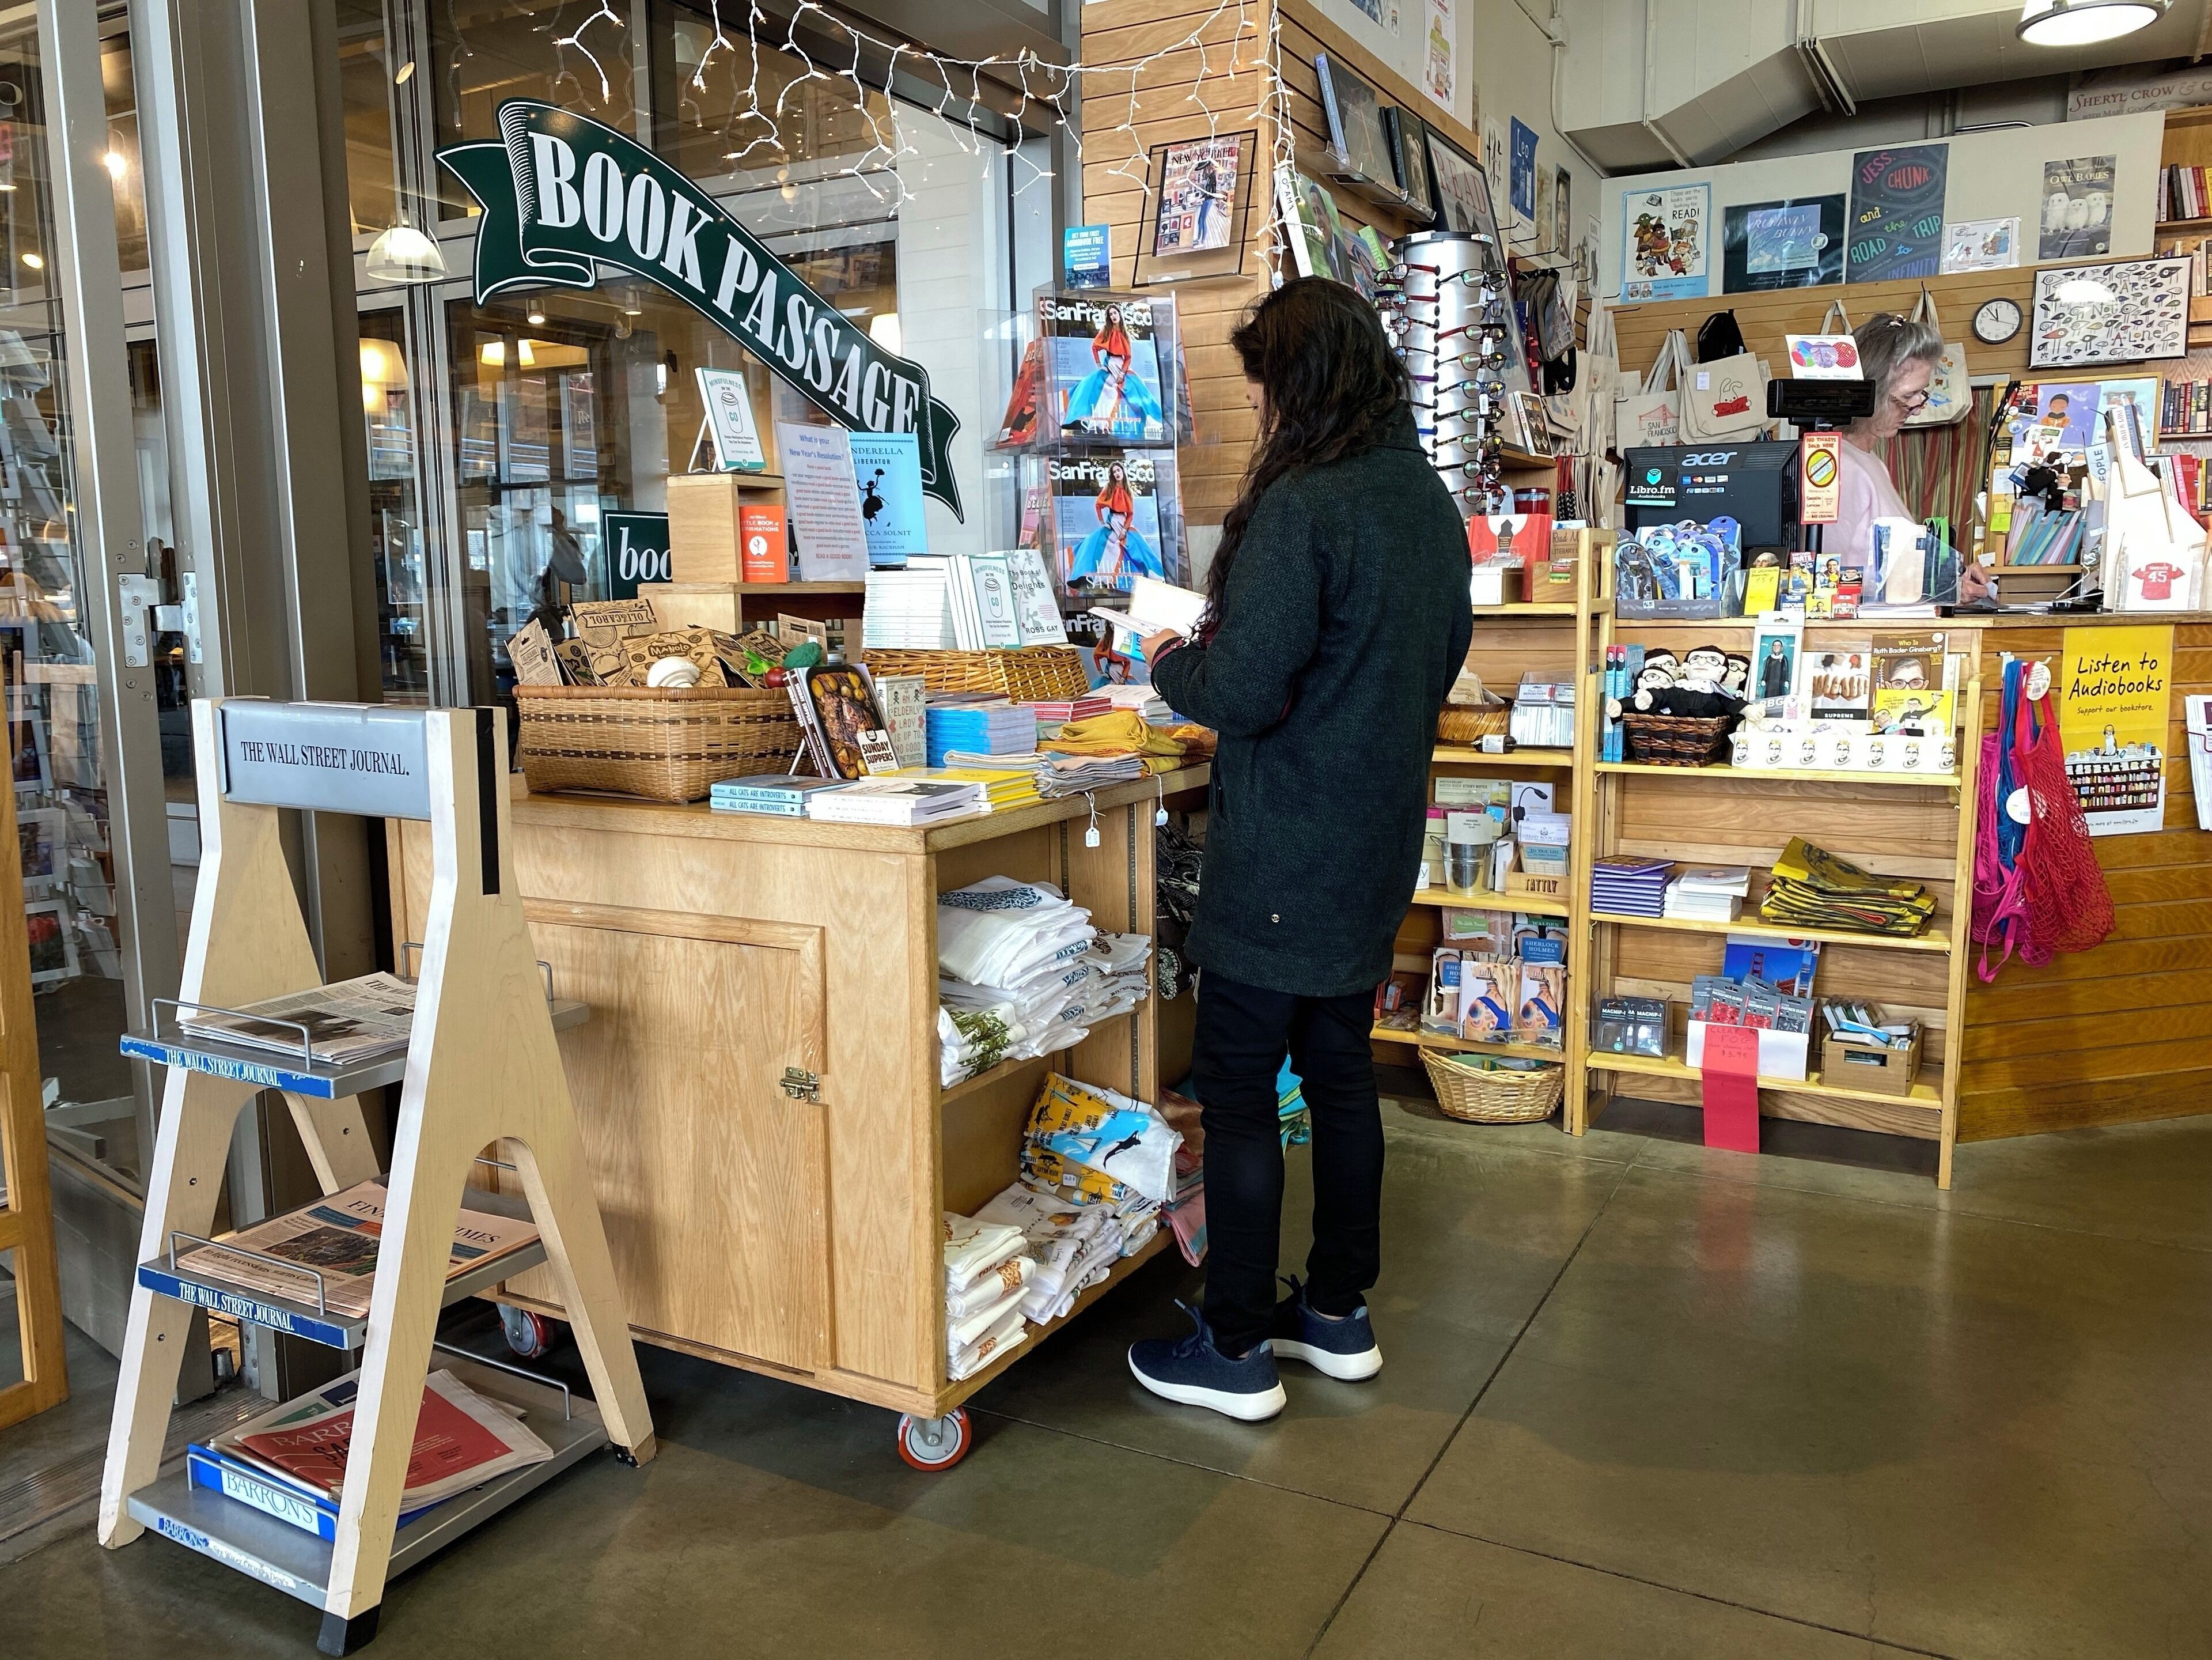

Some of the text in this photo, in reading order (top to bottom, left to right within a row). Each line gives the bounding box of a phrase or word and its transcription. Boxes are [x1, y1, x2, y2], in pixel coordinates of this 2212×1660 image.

[2070, 93, 2128, 112] SHERYL
[2132, 86, 2175, 100] CROW
[2179, 81, 2197, 96] &
[1516, 127, 1530, 158] Leo
[1172, 154, 1192, 165] NEW
[1431, 146, 1486, 214] READ
[2050, 172, 2109, 184] OWL BABIES
[1672, 208, 1700, 220] READ!
[1860, 206, 1881, 224] and
[1752, 214, 1816, 238] RUNAWAY BUNNY
[1884, 220, 1908, 233] the
[1912, 215, 1941, 238] TRIP
[1850, 238, 1886, 264] ROAD
[1895, 244, 1913, 256] to
[1888, 257, 1938, 279] INFINITY
[527, 131, 921, 433] BOOK PASSAGE
[709, 378, 742, 390] MINDFULNESS
[1091, 403, 1128, 418] HIGH
[729, 412, 738, 422] GO
[1081, 420, 1141, 434] STREET
[1647, 426, 1677, 437] FRANCISCO
[1648, 422, 1660, 430] SAN
[800, 434, 813, 443] What
[801, 449, 816, 457] Year's
[817, 452, 844, 460] Resolution?
[1681, 452, 1737, 466] acer
[1630, 486, 1675, 494] Libro.fm
[1552, 531, 1567, 543] Read
[975, 565, 1005, 574] MINDFULNESS
[2148, 570, 2167, 583] 45
[1012, 581, 1046, 592] Delights
[991, 597, 999, 606] GO
[1025, 626, 1045, 634] ROSS
[650, 642, 690, 656] MANOLO
[1908, 645, 1942, 654] Ginsburg?
[2077, 652, 2157, 675] Listen to
[2069, 674, 2163, 700] Audiobooks
[795, 683, 813, 725] SUNDAY SUPPERS
[903, 695, 910, 704] AN
[793, 703, 804, 727] SUPPERS
[893, 706, 920, 717] ELDERLY
[2077, 705, 2103, 716] Support
[899, 720, 915, 729] LADY
[904, 732, 911, 741] UP
[913, 731, 921, 739] TO
[862, 741, 889, 755] SUNDAY
[906, 744, 921, 753] GOOD
[240, 741, 410, 777] THE WALL STREET JOURNAL.
[866, 752, 893, 765] SUPPERS
[760, 790, 786, 799] INTROVERTS
[759, 803, 785, 812] INTROVERTS
[1526, 879, 1558, 893] TATTLY
[364, 980, 392, 992] THE
[1721, 1035, 1750, 1043] FOG
[1721, 1050, 1748, 1058] $3.95
[165, 1049, 282, 1088] THE WALL STREET JOURNAL.
[214, 1249, 230, 1260] fight
[179, 1282, 294, 1332] THE WALL STREET JOURNAL.
